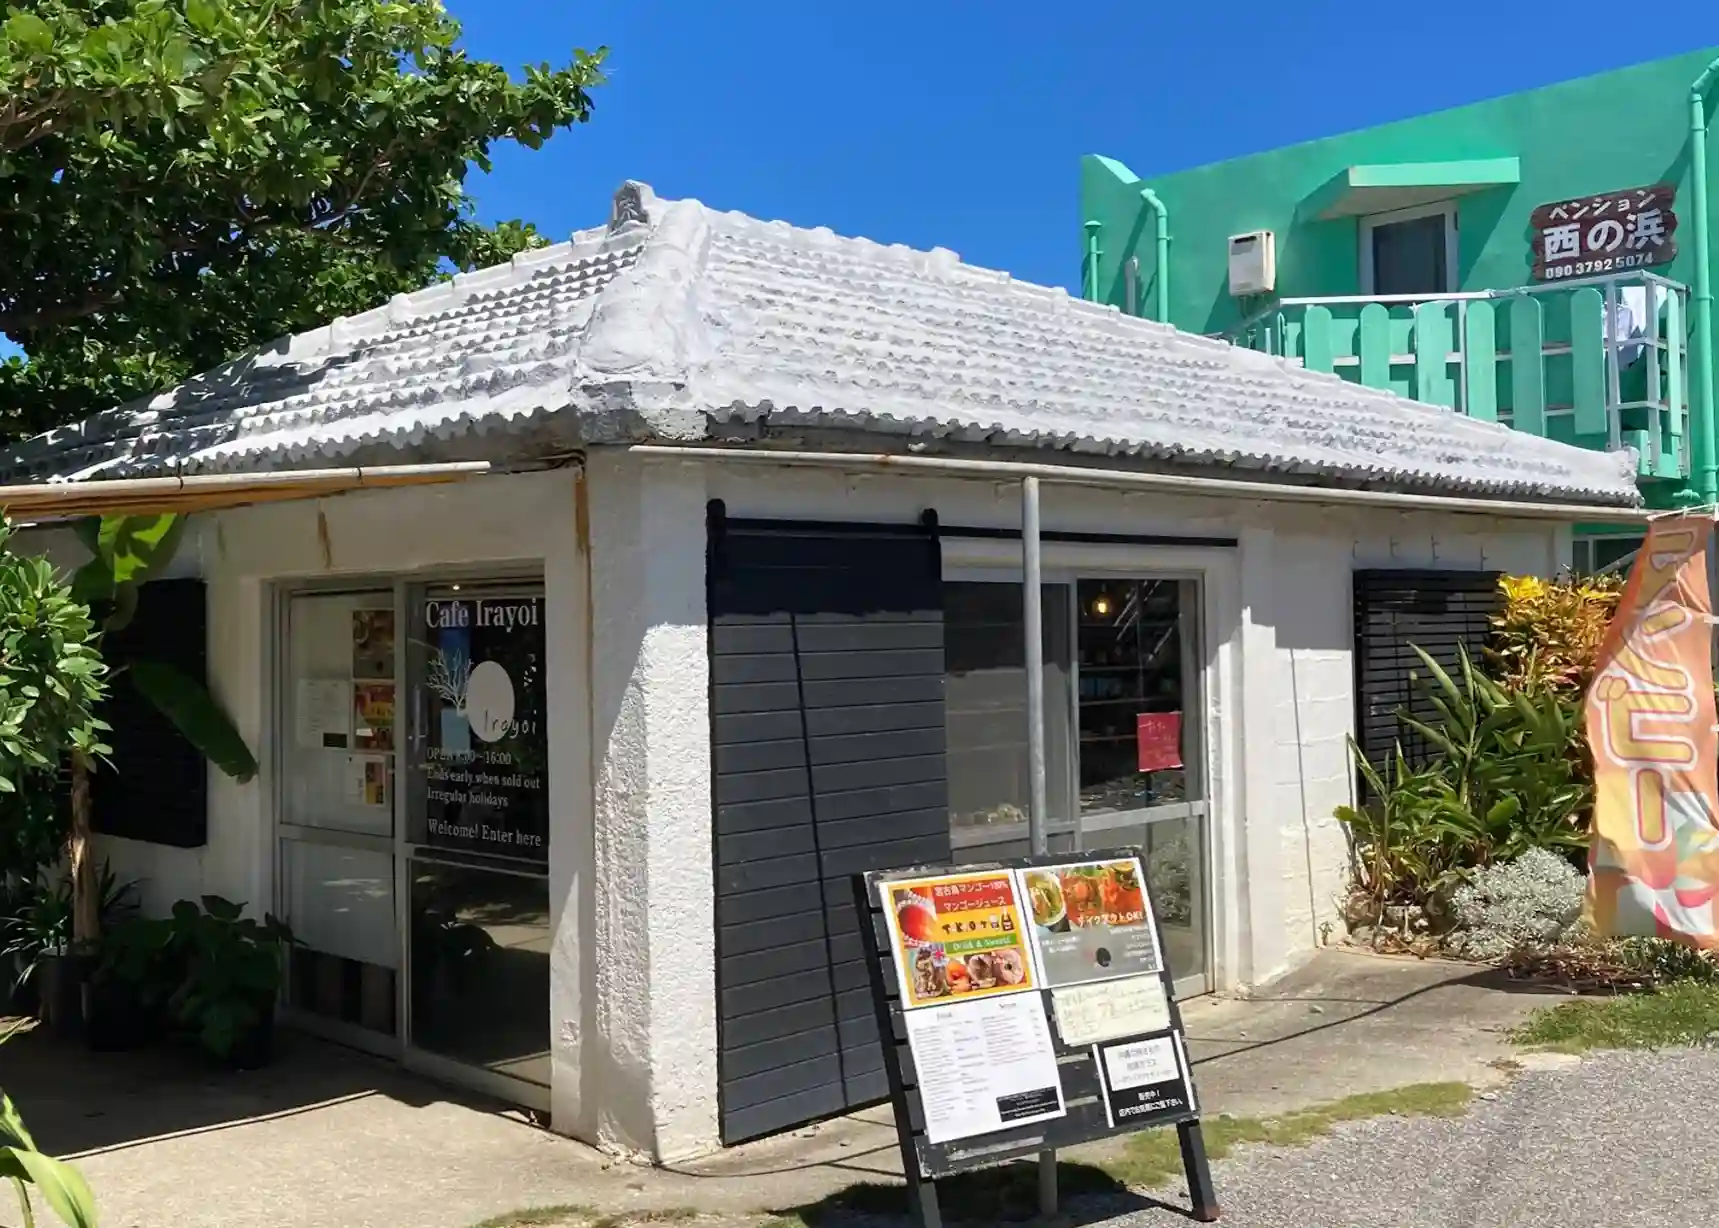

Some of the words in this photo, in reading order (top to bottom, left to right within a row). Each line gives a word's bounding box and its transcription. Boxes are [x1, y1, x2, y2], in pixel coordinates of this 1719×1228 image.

[1548, 189, 1657, 221] ペンション
[1543, 208, 1665, 263] 西の浜
[1545, 265, 1573, 279] 090
[1575, 258, 1613, 275] 3792
[1615, 252, 1653, 269] 5074
[425, 600, 470, 628] Cafe
[475, 597, 539, 632] Irayoi
[450, 769, 473, 786] early
[475, 772, 500, 785] when
[501, 774, 522, 788] sold
[524, 777, 541, 789] out
[427, 787, 467, 805] Irregular
[469, 791, 509, 809] holidays
[428, 818, 479, 839] Welcome!
[481, 825, 513, 843] Enter
[515, 829, 542, 847] here
[943, 895, 1007, 912] マンゴージュース
